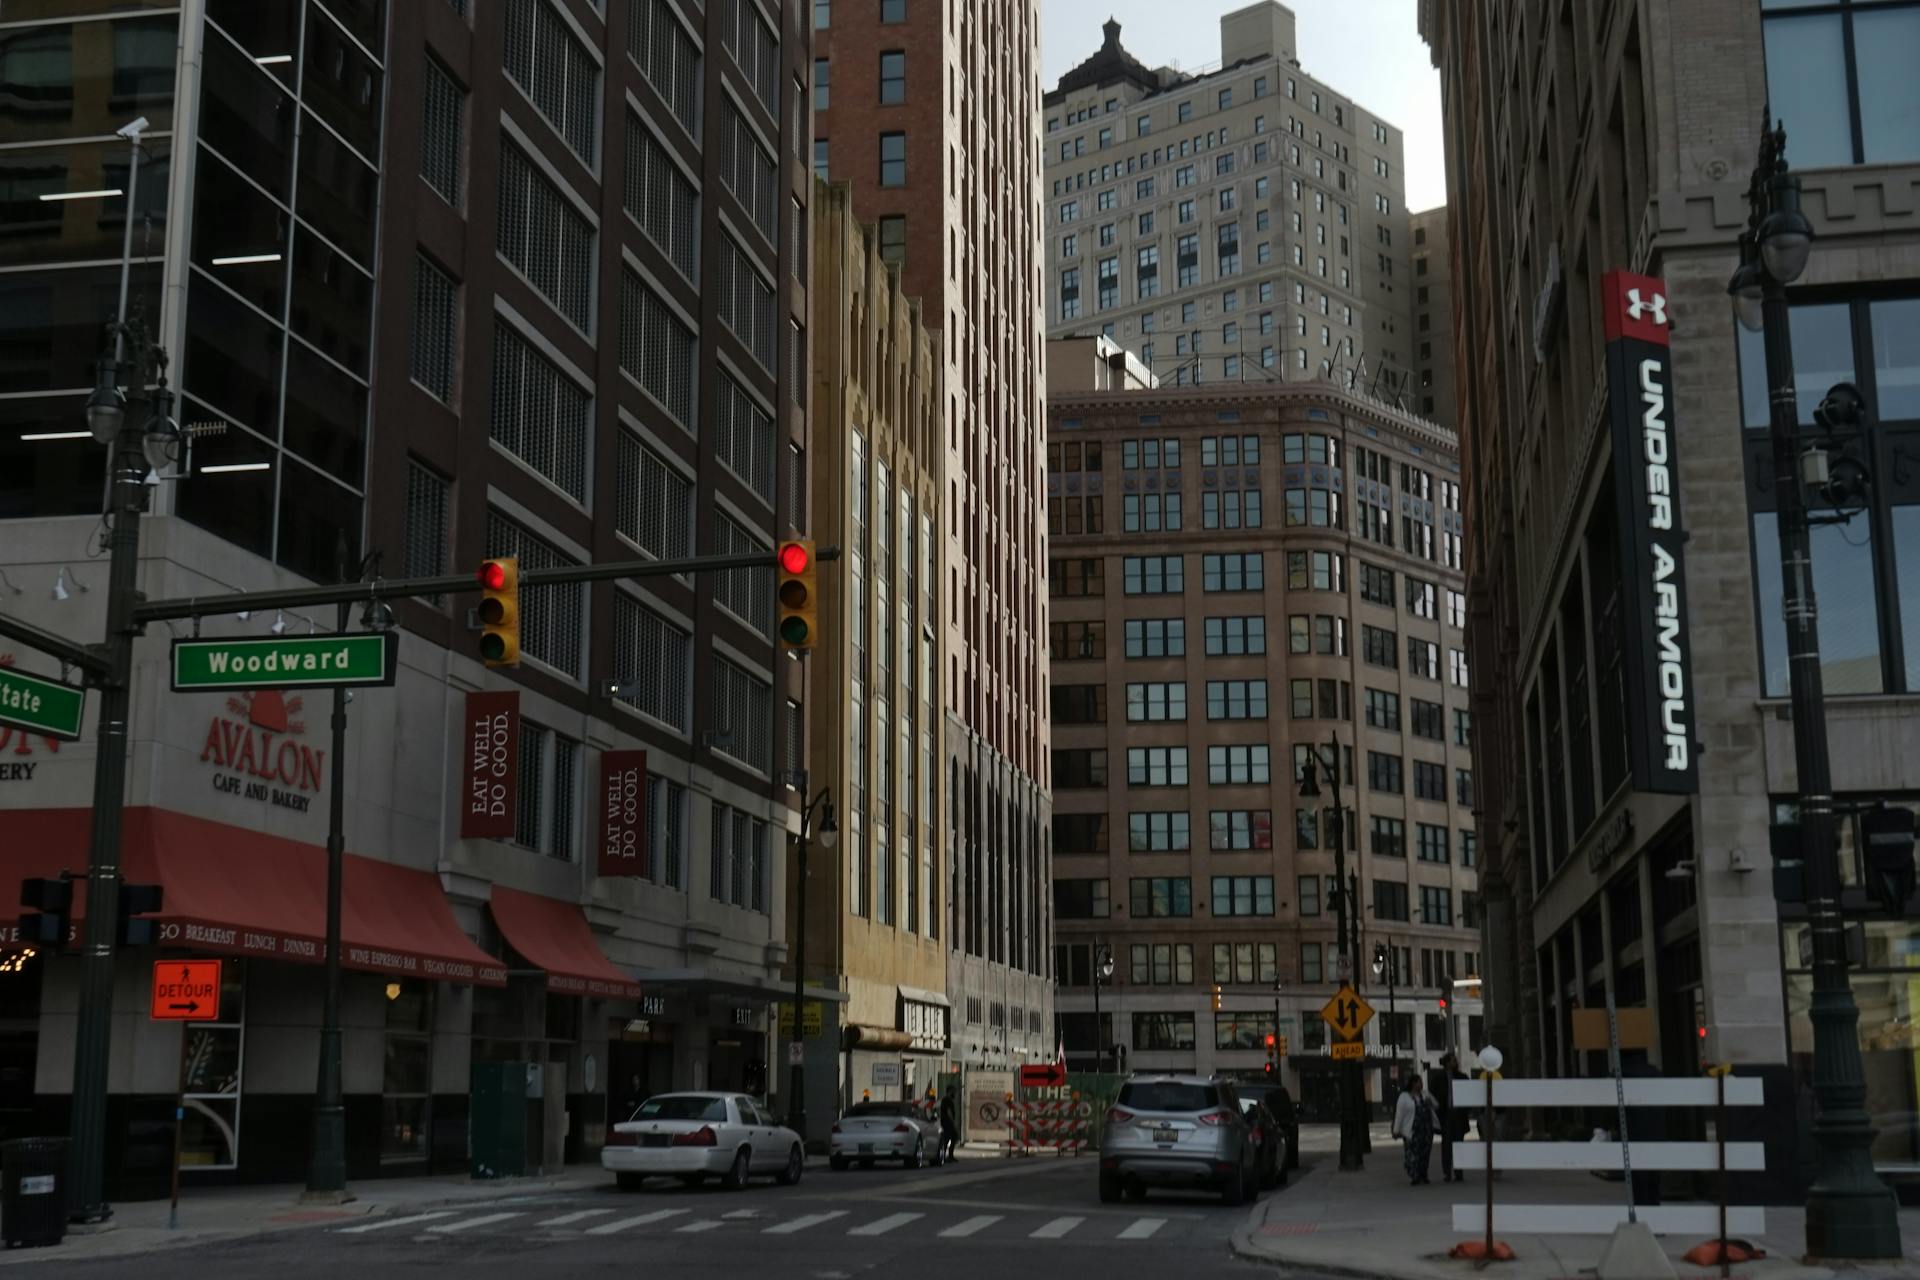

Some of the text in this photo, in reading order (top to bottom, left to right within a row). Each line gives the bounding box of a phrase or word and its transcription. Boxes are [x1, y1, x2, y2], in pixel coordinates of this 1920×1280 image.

[1638, 358, 1688, 772] UNDER ARMOUR
[208, 648, 350, 674] Woodward
[0, 682, 41, 713] tate
[200, 716, 326, 792] AVALON
[472, 714, 491, 815] EAT WELL
[490, 710, 510, 817] DO GOOD.
[212, 772, 312, 813] CAFE AND BAKERY
[606, 770, 622, 857] EAT WELL
[622, 767, 639, 860] DO GOOD.
[185, 923, 237, 946] BREAKFAST
[244, 932, 277, 951] LUNCH
[283, 938, 316, 957] DINNER
[371, 951, 403, 969] ESPRESSO
[158, 983, 214, 998] DETOUR
[643, 996, 664, 1014] PARK
[736, 1007, 751, 1025] EXIT
[1335, 1046, 1361, 1057] AHEAD
